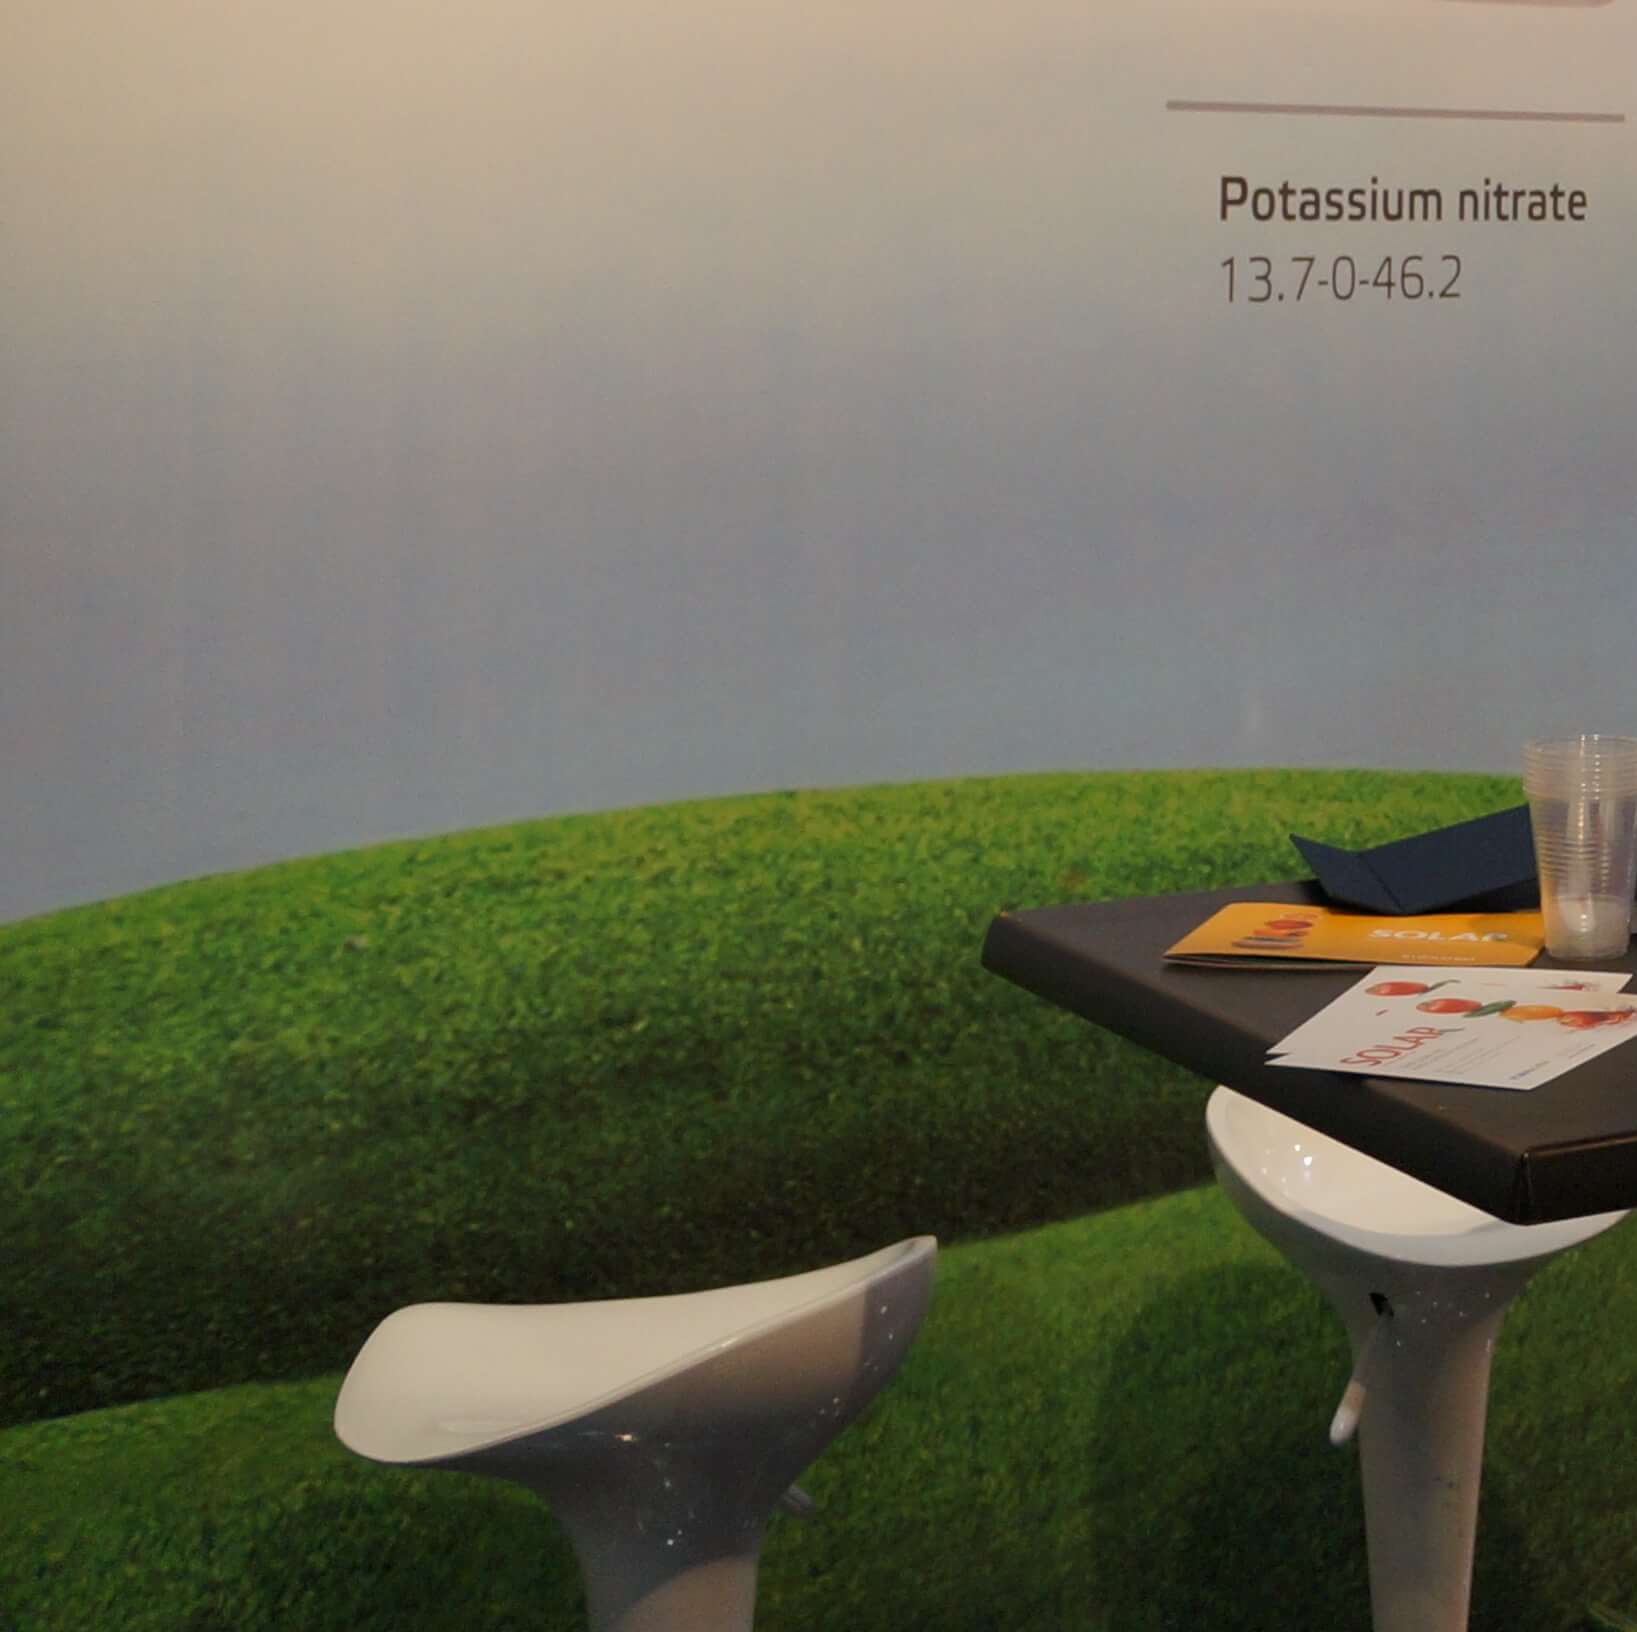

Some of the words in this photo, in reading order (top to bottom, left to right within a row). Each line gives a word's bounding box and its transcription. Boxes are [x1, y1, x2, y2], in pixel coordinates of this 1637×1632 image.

[1219, 176, 1443, 223] Potassium
[1458, 177, 1588, 222] nitrate
[1219, 254, 1462, 305] 13.7-0-46.2
